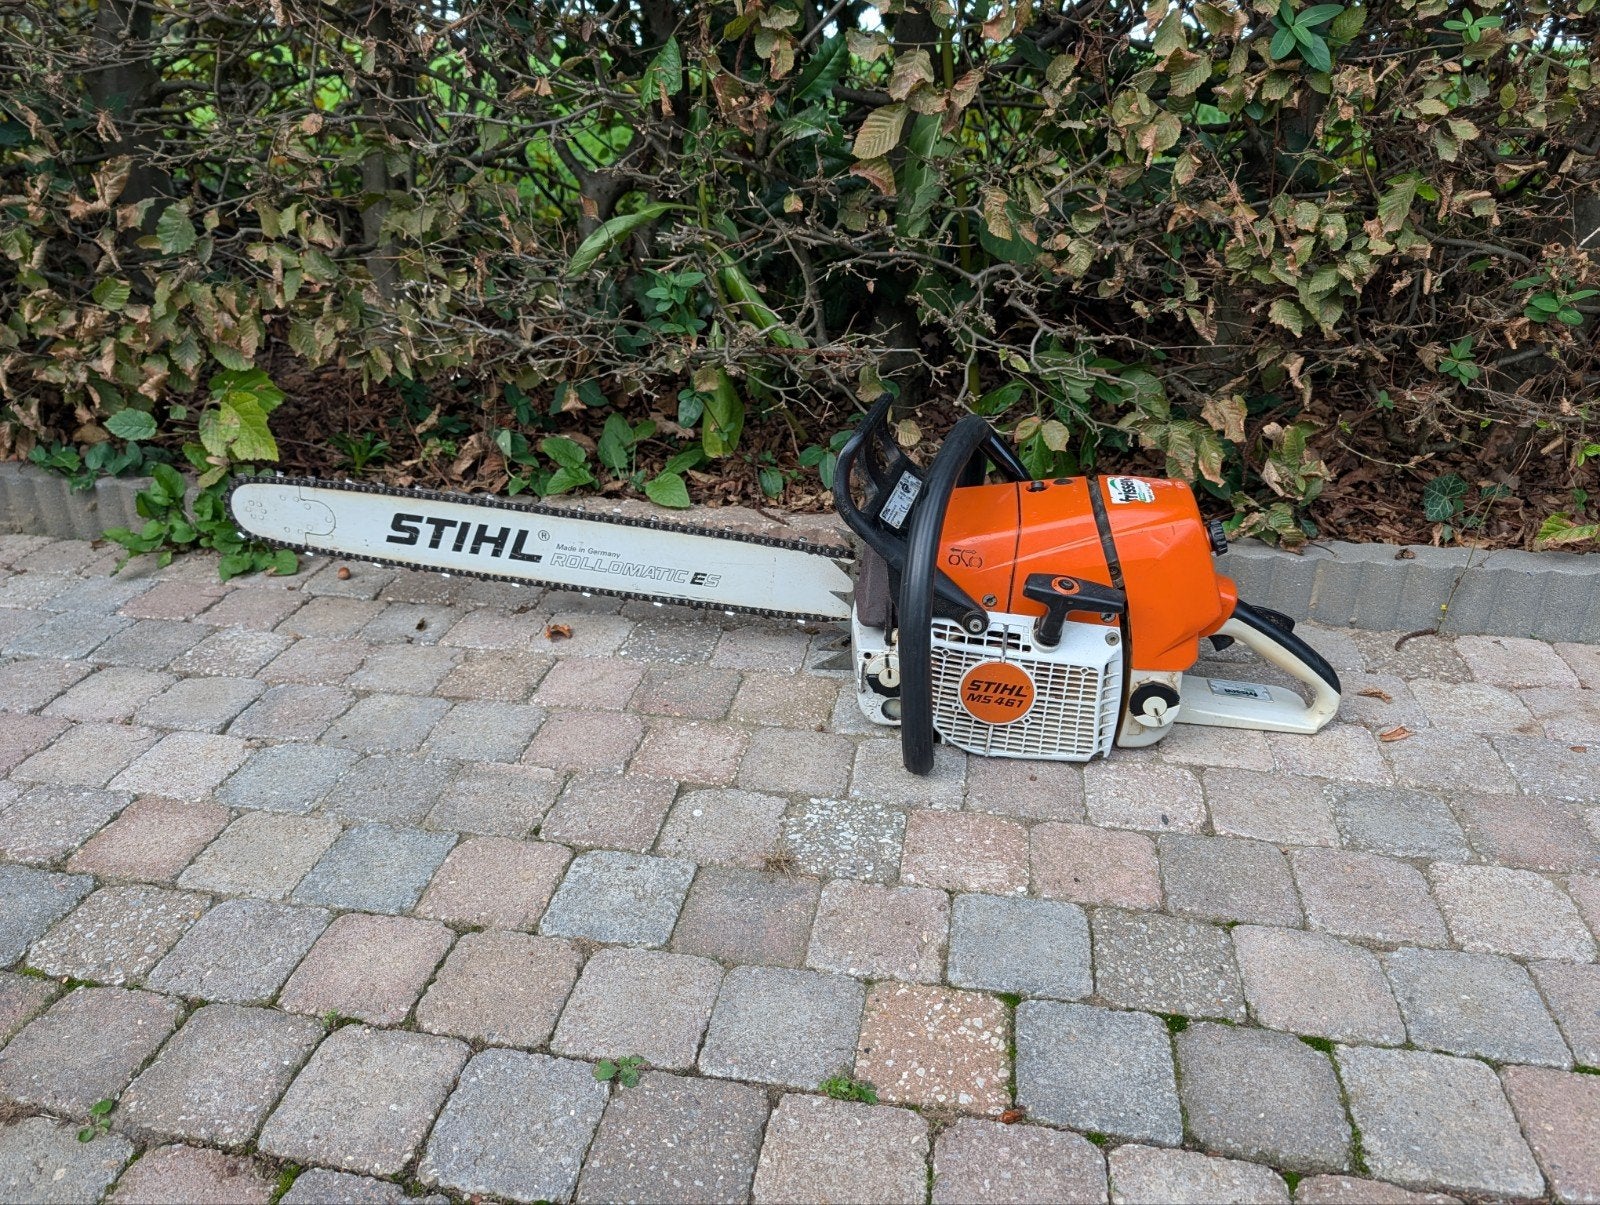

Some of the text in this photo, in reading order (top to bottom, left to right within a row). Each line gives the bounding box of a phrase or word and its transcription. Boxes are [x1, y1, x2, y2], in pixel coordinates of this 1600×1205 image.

[556, 543, 577, 552] Made
[587, 547, 622, 559] Germany
[550, 552, 722, 588] ROLLOMATIC ES
[967, 679, 1028, 698] STIHL
[966, 693, 1024, 708] MS 461
